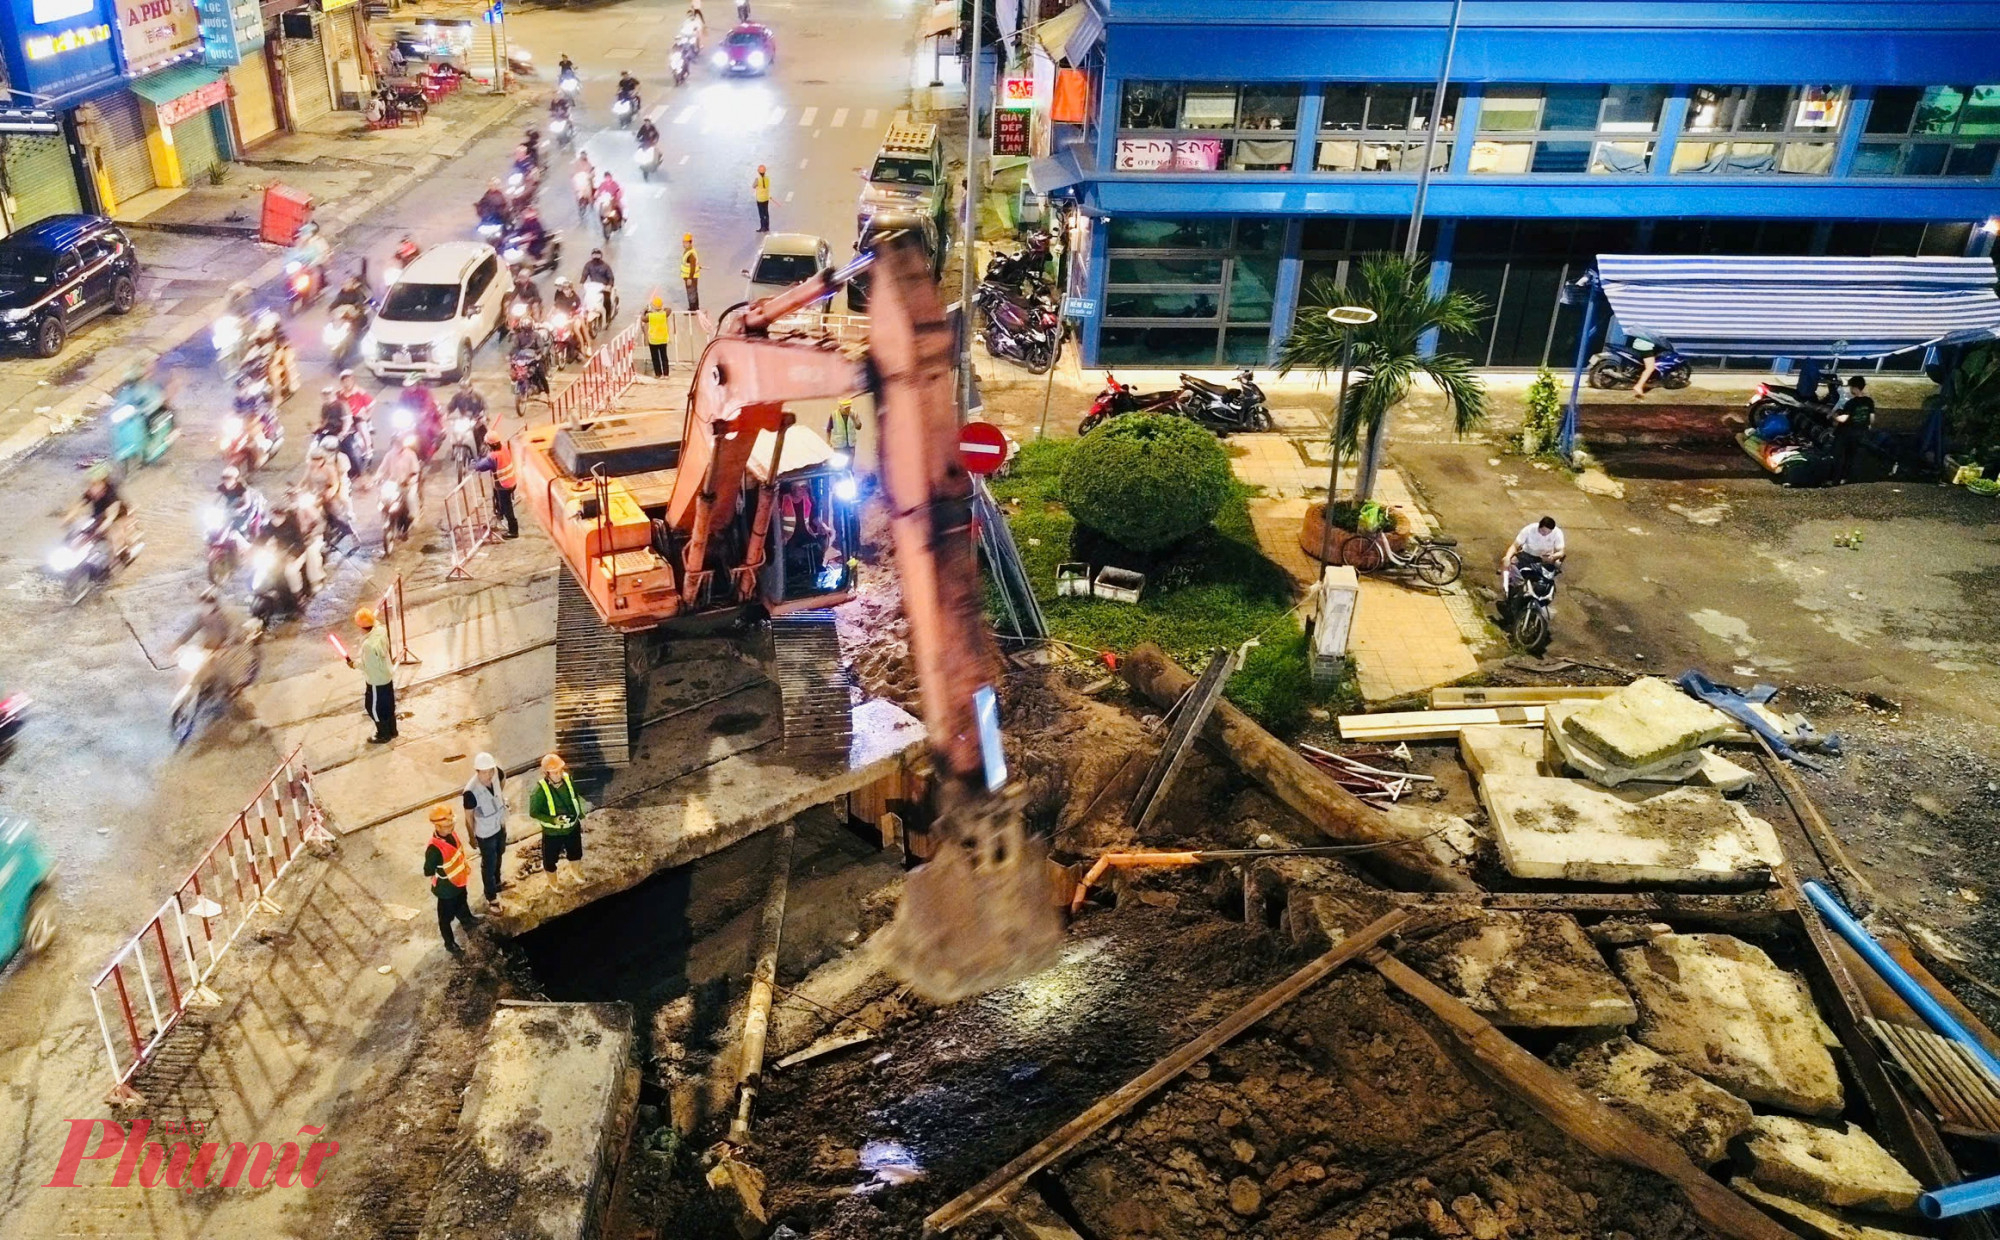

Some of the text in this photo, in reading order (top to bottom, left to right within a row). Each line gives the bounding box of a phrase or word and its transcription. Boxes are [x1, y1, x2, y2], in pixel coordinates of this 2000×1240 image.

[1001, 122, 1022, 131] DÉP
[999, 132, 1024, 142] THÁI
[1000, 144, 1021, 152] LAN
